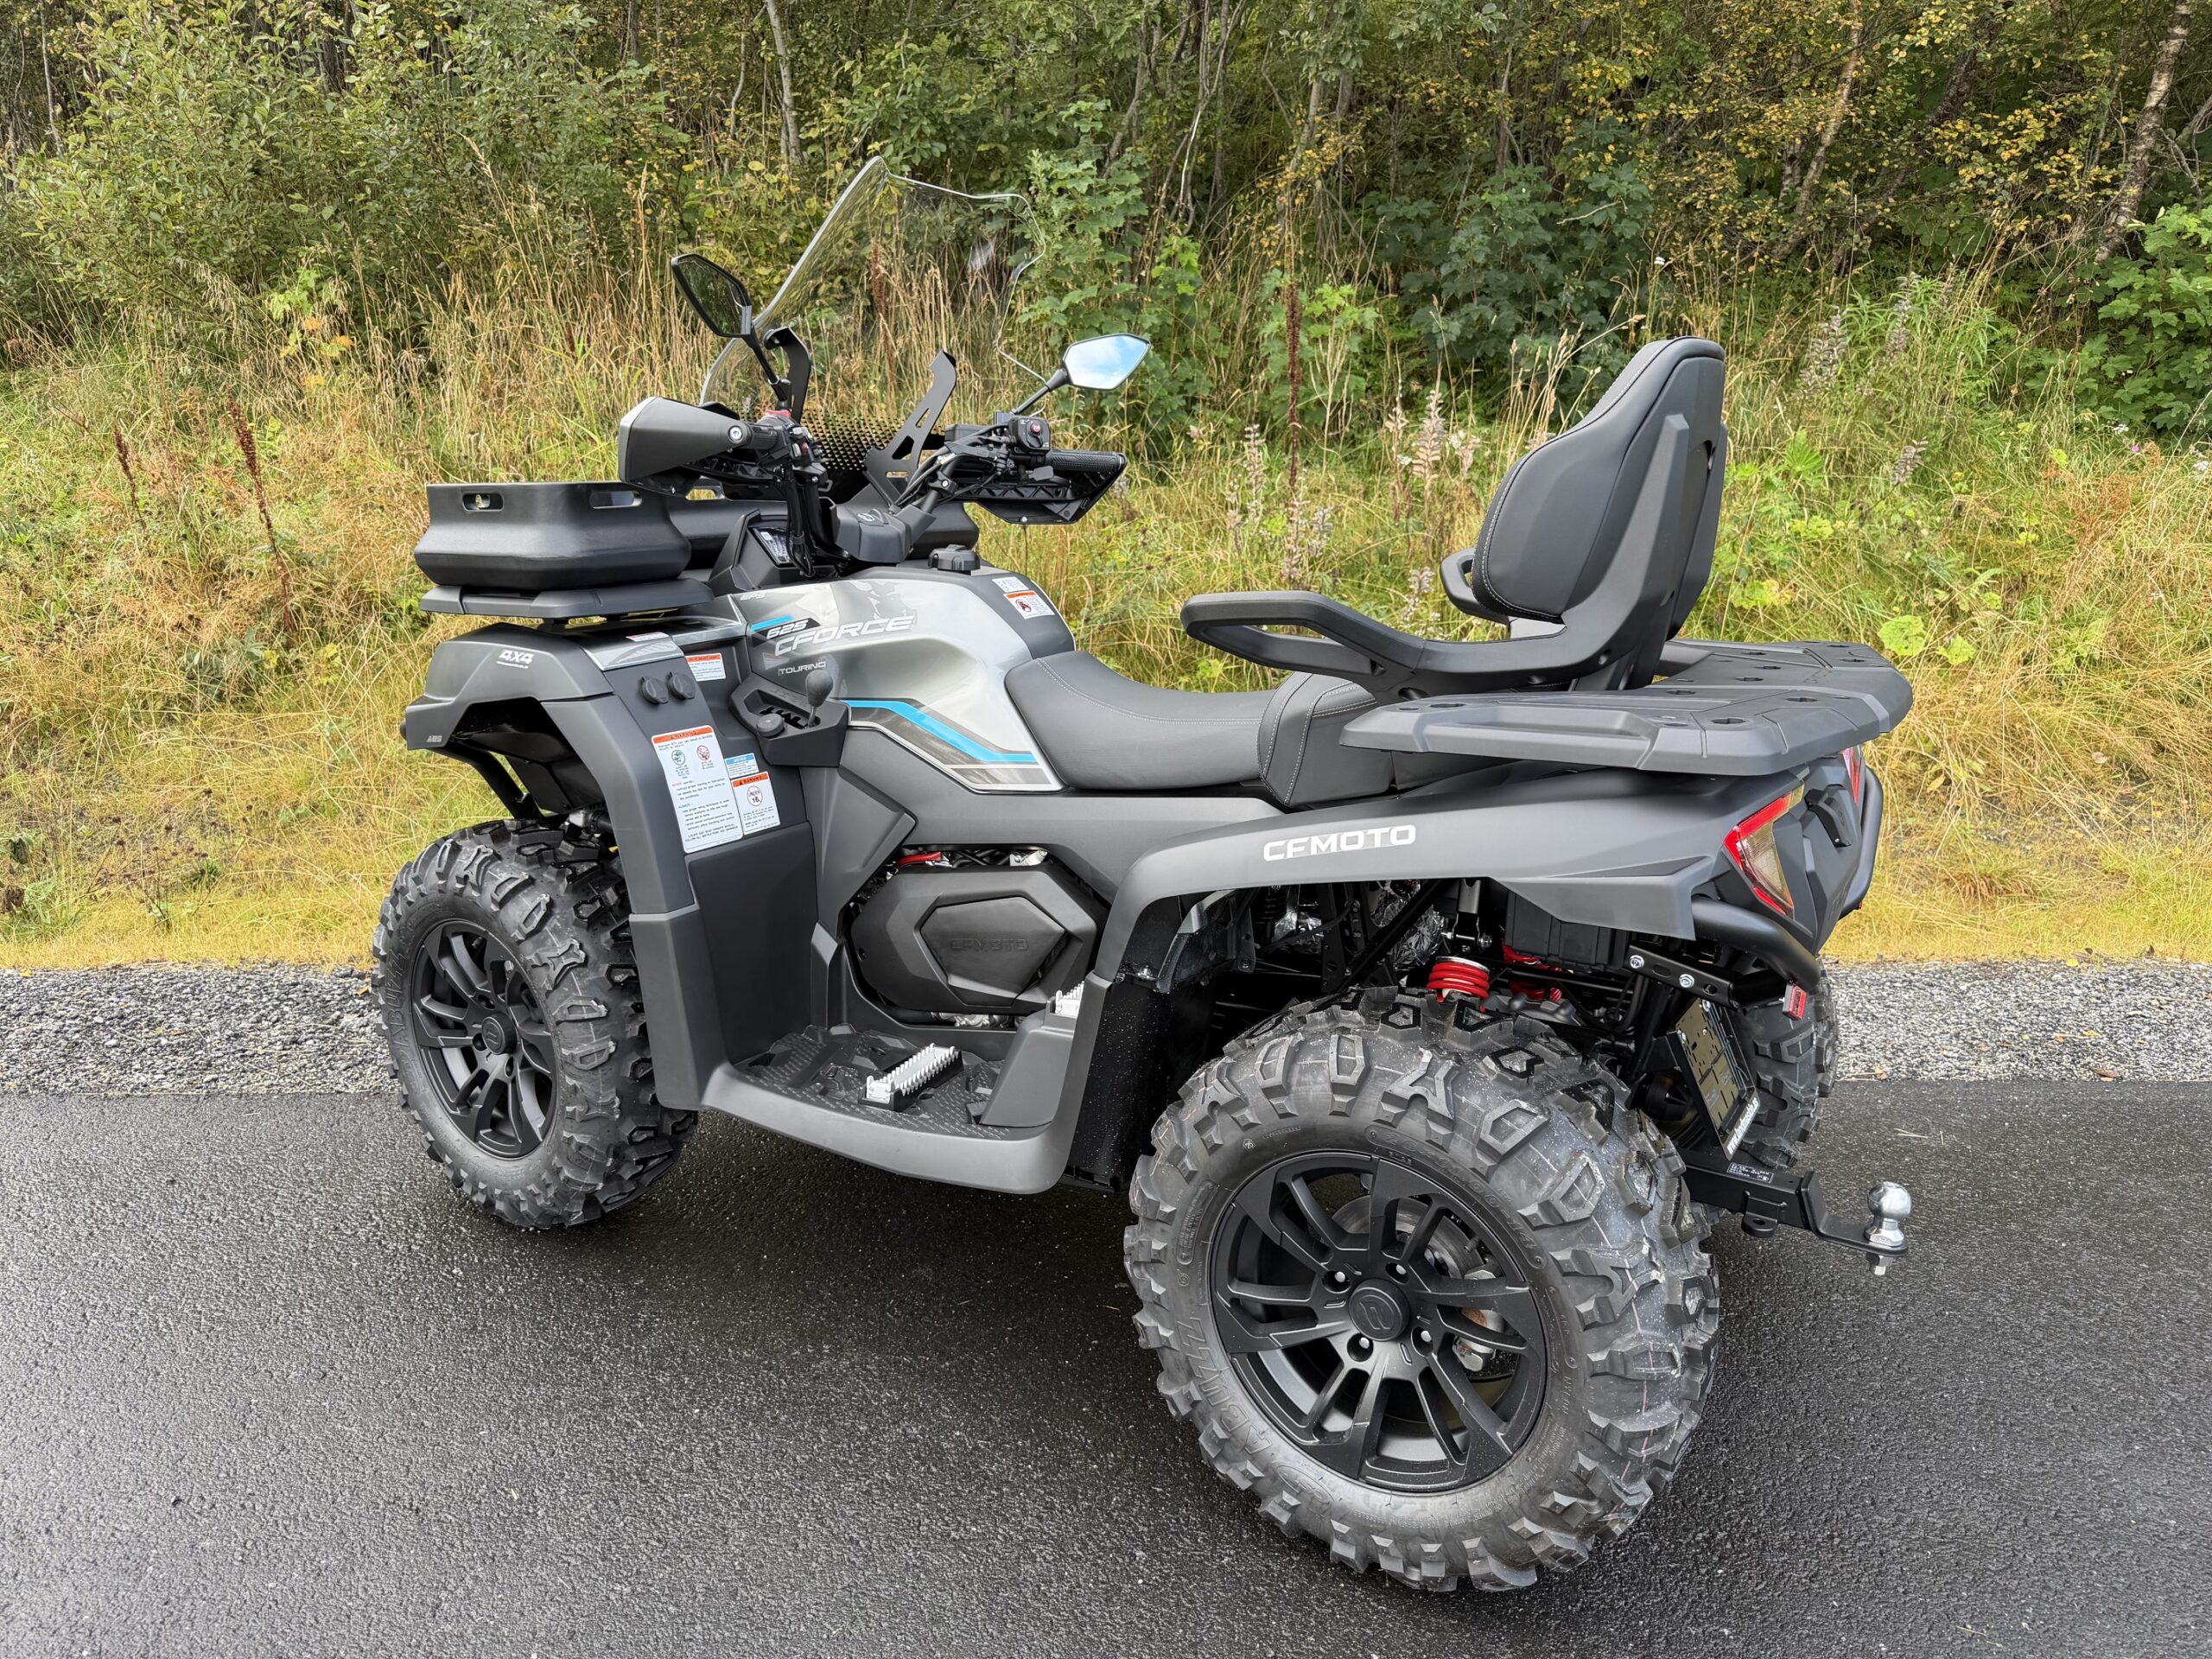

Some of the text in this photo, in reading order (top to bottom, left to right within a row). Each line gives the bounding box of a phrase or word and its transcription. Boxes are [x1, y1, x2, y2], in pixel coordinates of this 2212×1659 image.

[766, 619, 809, 640] 625
[775, 615, 916, 657] CFORCE
[499, 649, 535, 664] 4X4
[779, 660, 827, 676] TOURING
[1263, 824, 1416, 861] CFMOTO
[1176, 1316, 1273, 1455] ABUZZ
